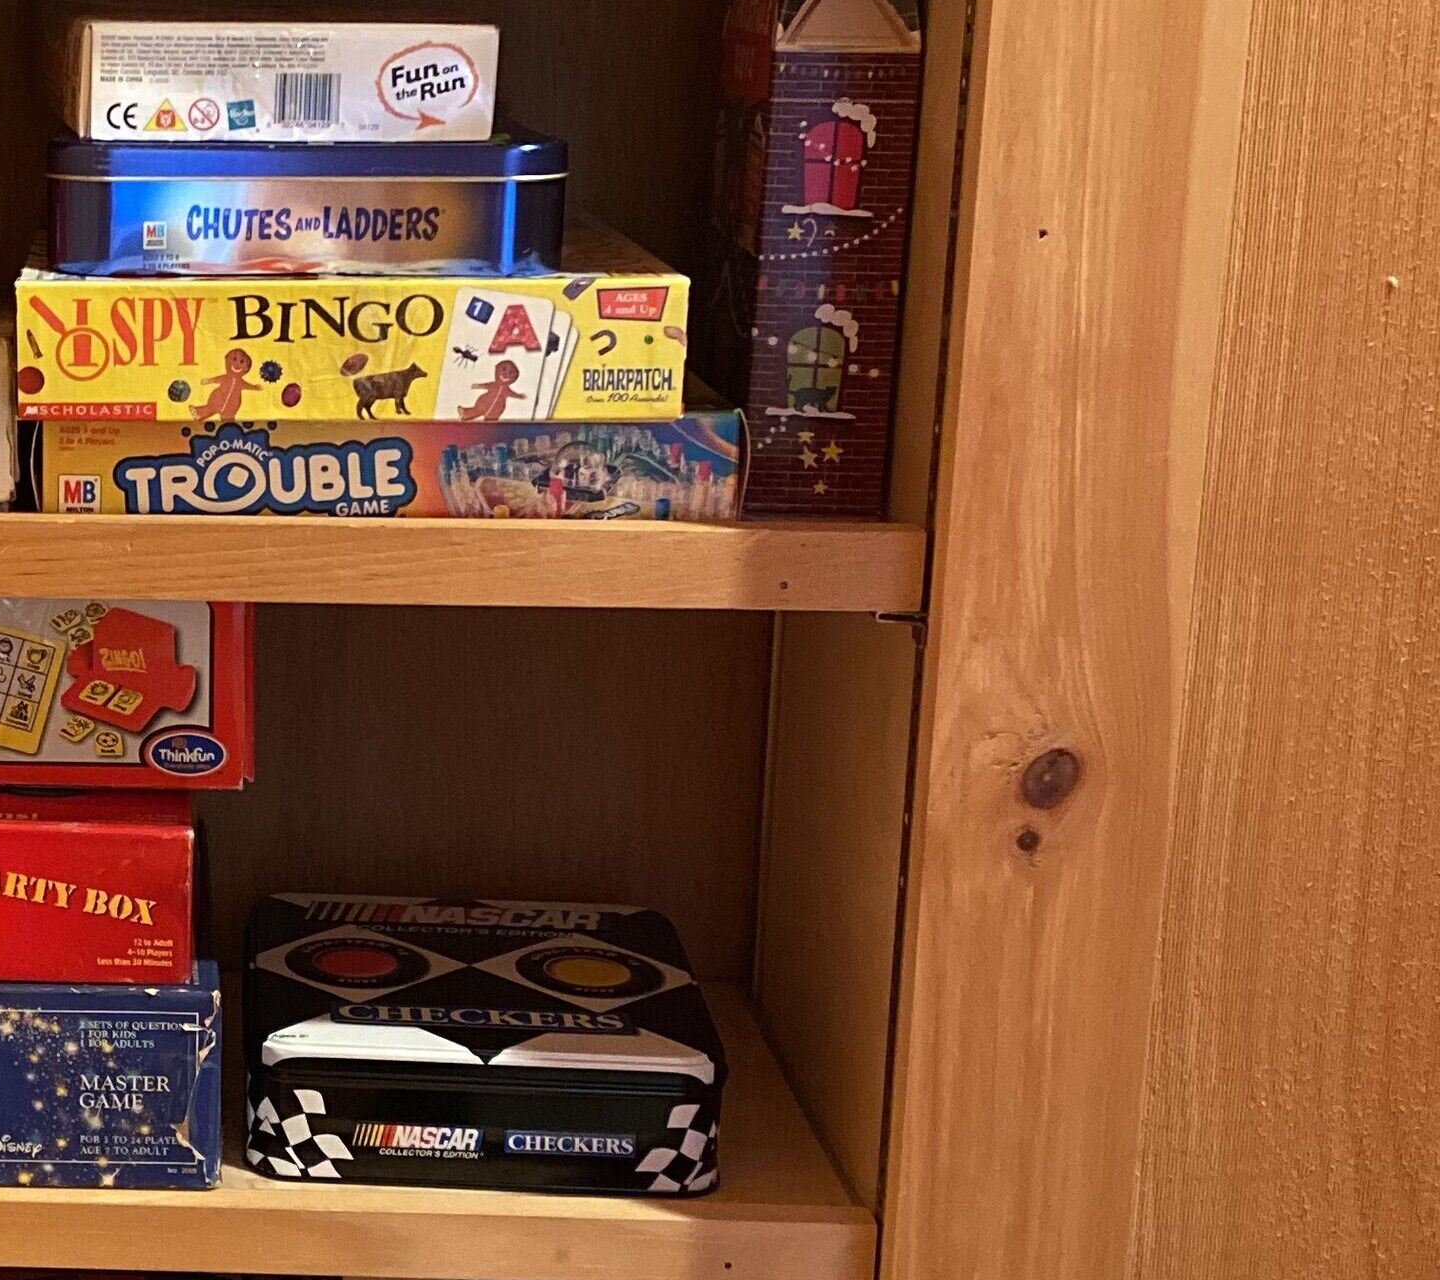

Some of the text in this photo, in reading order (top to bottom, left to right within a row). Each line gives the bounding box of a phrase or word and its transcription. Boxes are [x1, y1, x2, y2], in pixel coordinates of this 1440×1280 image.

[391, 61, 459, 88] Fun on
[395, 76, 466, 102] the Run
[186, 205, 440, 242] CHUTES LADDERS
[111, 293, 444, 367] SPY BINGO
[583, 364, 672, 391] BRIARPATCH
[39, 404, 152, 416] SCHOLASTIC
[197, 438, 269, 467] POP-O-MATIC
[63, 481, 96, 504] MB
[125, 448, 405, 513] TROUBLE
[335, 500, 390, 517] GAME
[83, 889, 158, 927] BOX
[401, 905, 601, 930] NASCAR
[338, 1003, 625, 1031] CHECKERS
[79, 1074, 171, 1093] MASTER
[79, 1092, 143, 1111] GAME
[379, 1147, 442, 1158] COLLECTOR'S
[395, 1124, 634, 1156] NASCAR CHECKERS
